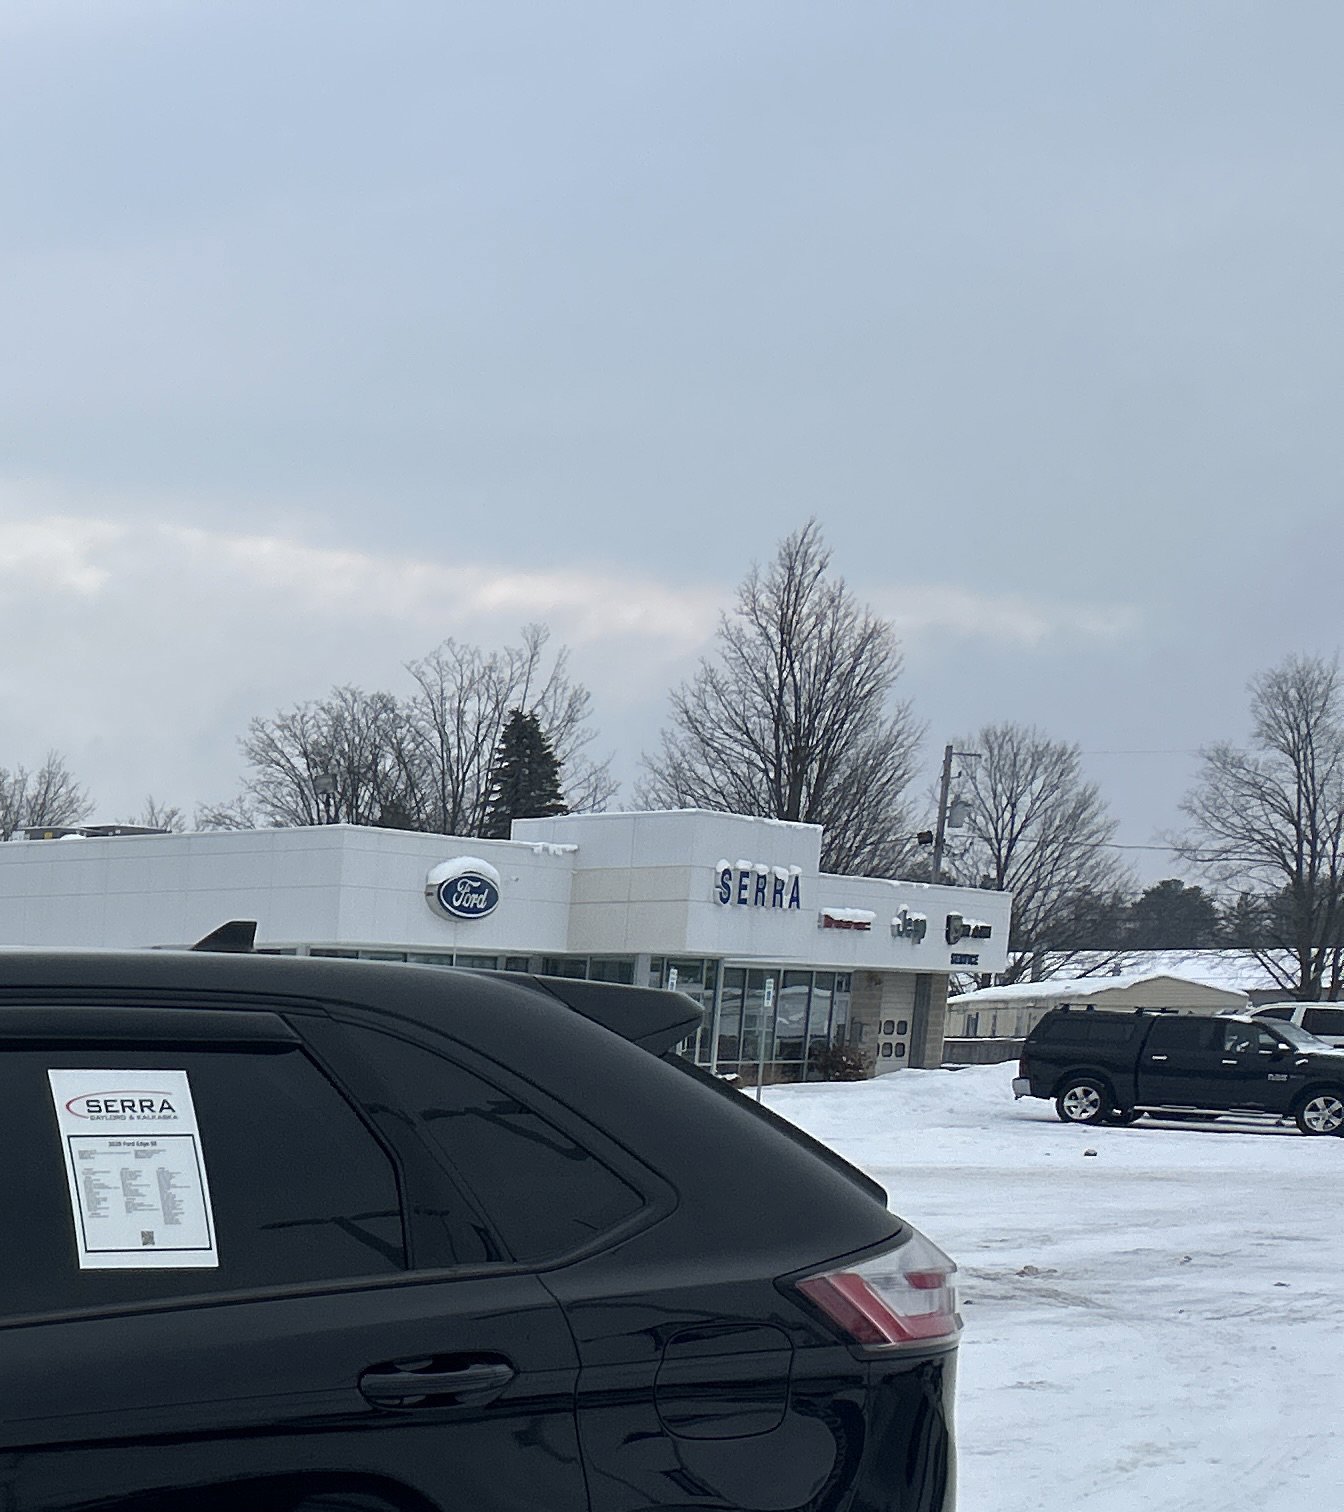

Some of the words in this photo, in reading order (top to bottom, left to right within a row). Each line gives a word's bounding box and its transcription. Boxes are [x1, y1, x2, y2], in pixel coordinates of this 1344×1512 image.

[452, 878, 489, 909] Ford
[718, 868, 801, 910] SERRA
[86, 1099, 176, 1113] SERRA
